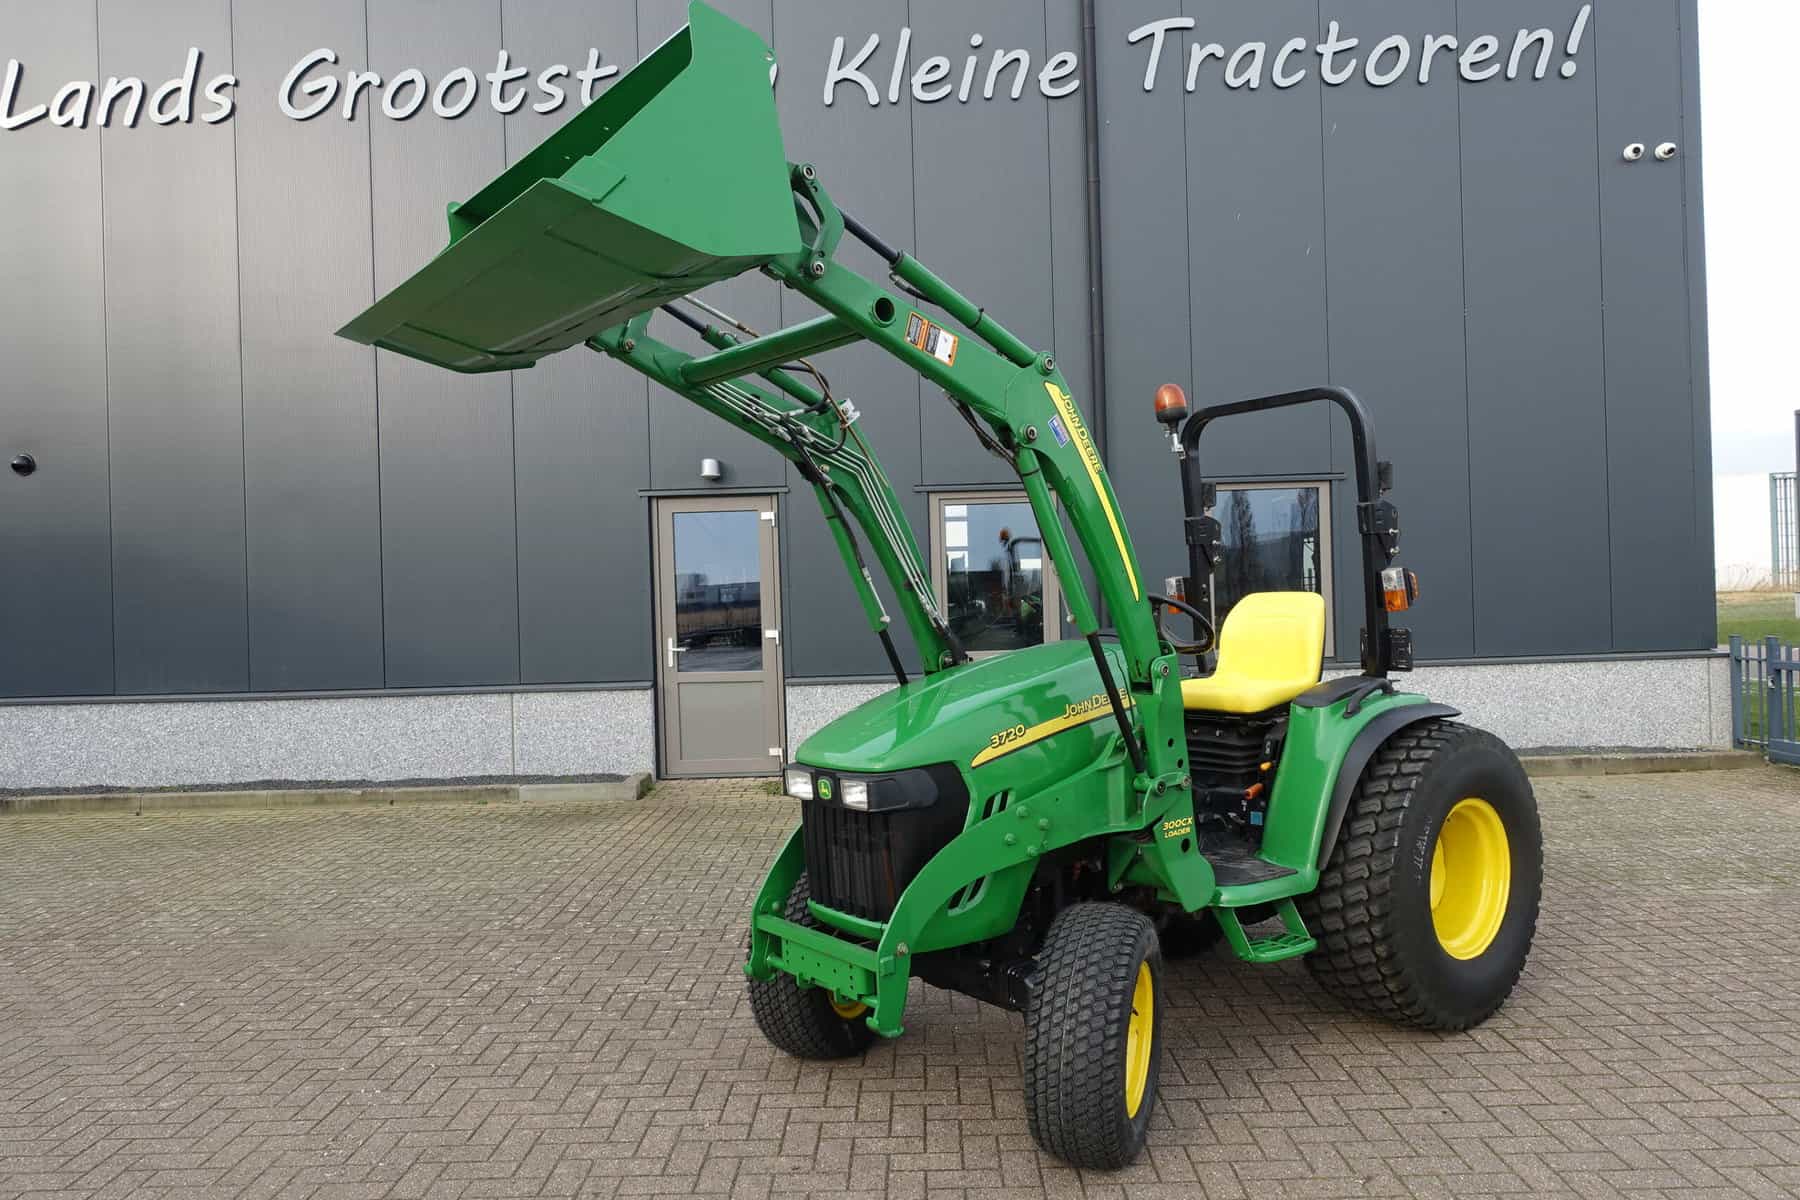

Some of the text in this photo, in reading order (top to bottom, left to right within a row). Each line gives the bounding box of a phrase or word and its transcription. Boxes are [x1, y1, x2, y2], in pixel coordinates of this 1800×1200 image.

[0, 47, 238, 131] Lands
[823, 27, 1081, 107] Kleine
[1128, 4, 1592, 92] Tractoren!
[1060, 394, 1103, 473] JOHN DEERE
[1063, 687, 1128, 719] JOHN DEE
[990, 724, 1026, 749] 3720
[1162, 816, 1193, 831] 300CX
